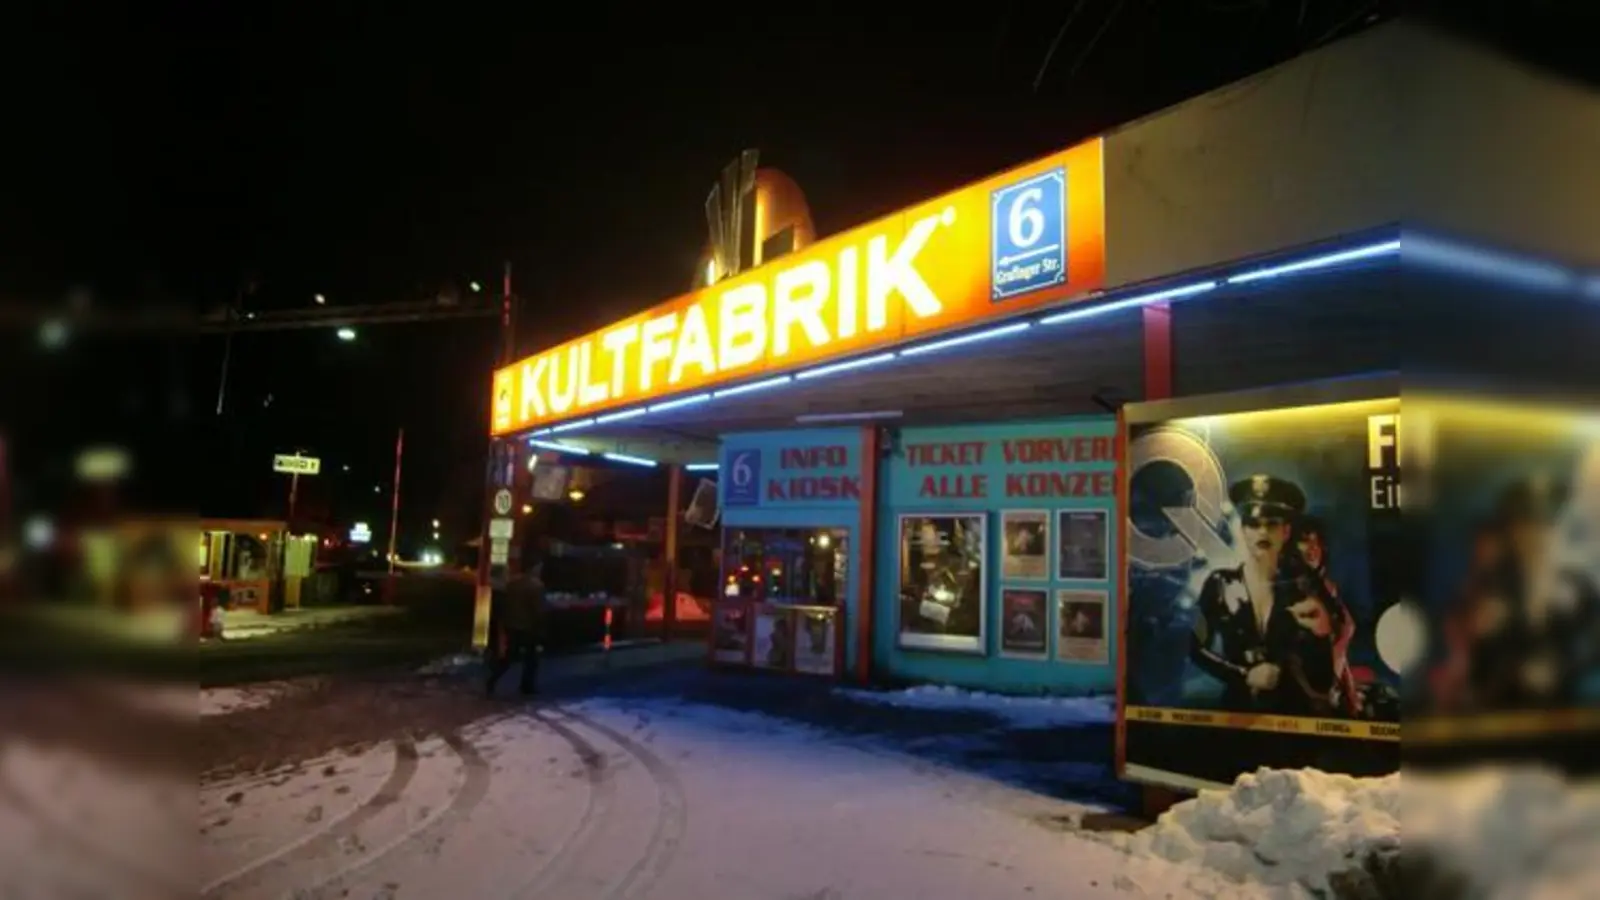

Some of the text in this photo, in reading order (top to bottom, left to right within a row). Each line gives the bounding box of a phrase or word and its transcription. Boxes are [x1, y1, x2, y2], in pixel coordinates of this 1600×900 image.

[1009, 187, 1045, 248] 6
[780, 445, 847, 469] INFO
[906, 441, 988, 467] TICKET
[732, 453, 752, 487] 6
[768, 476, 861, 501] KIOSK
[920, 473, 988, 498] ALLE
